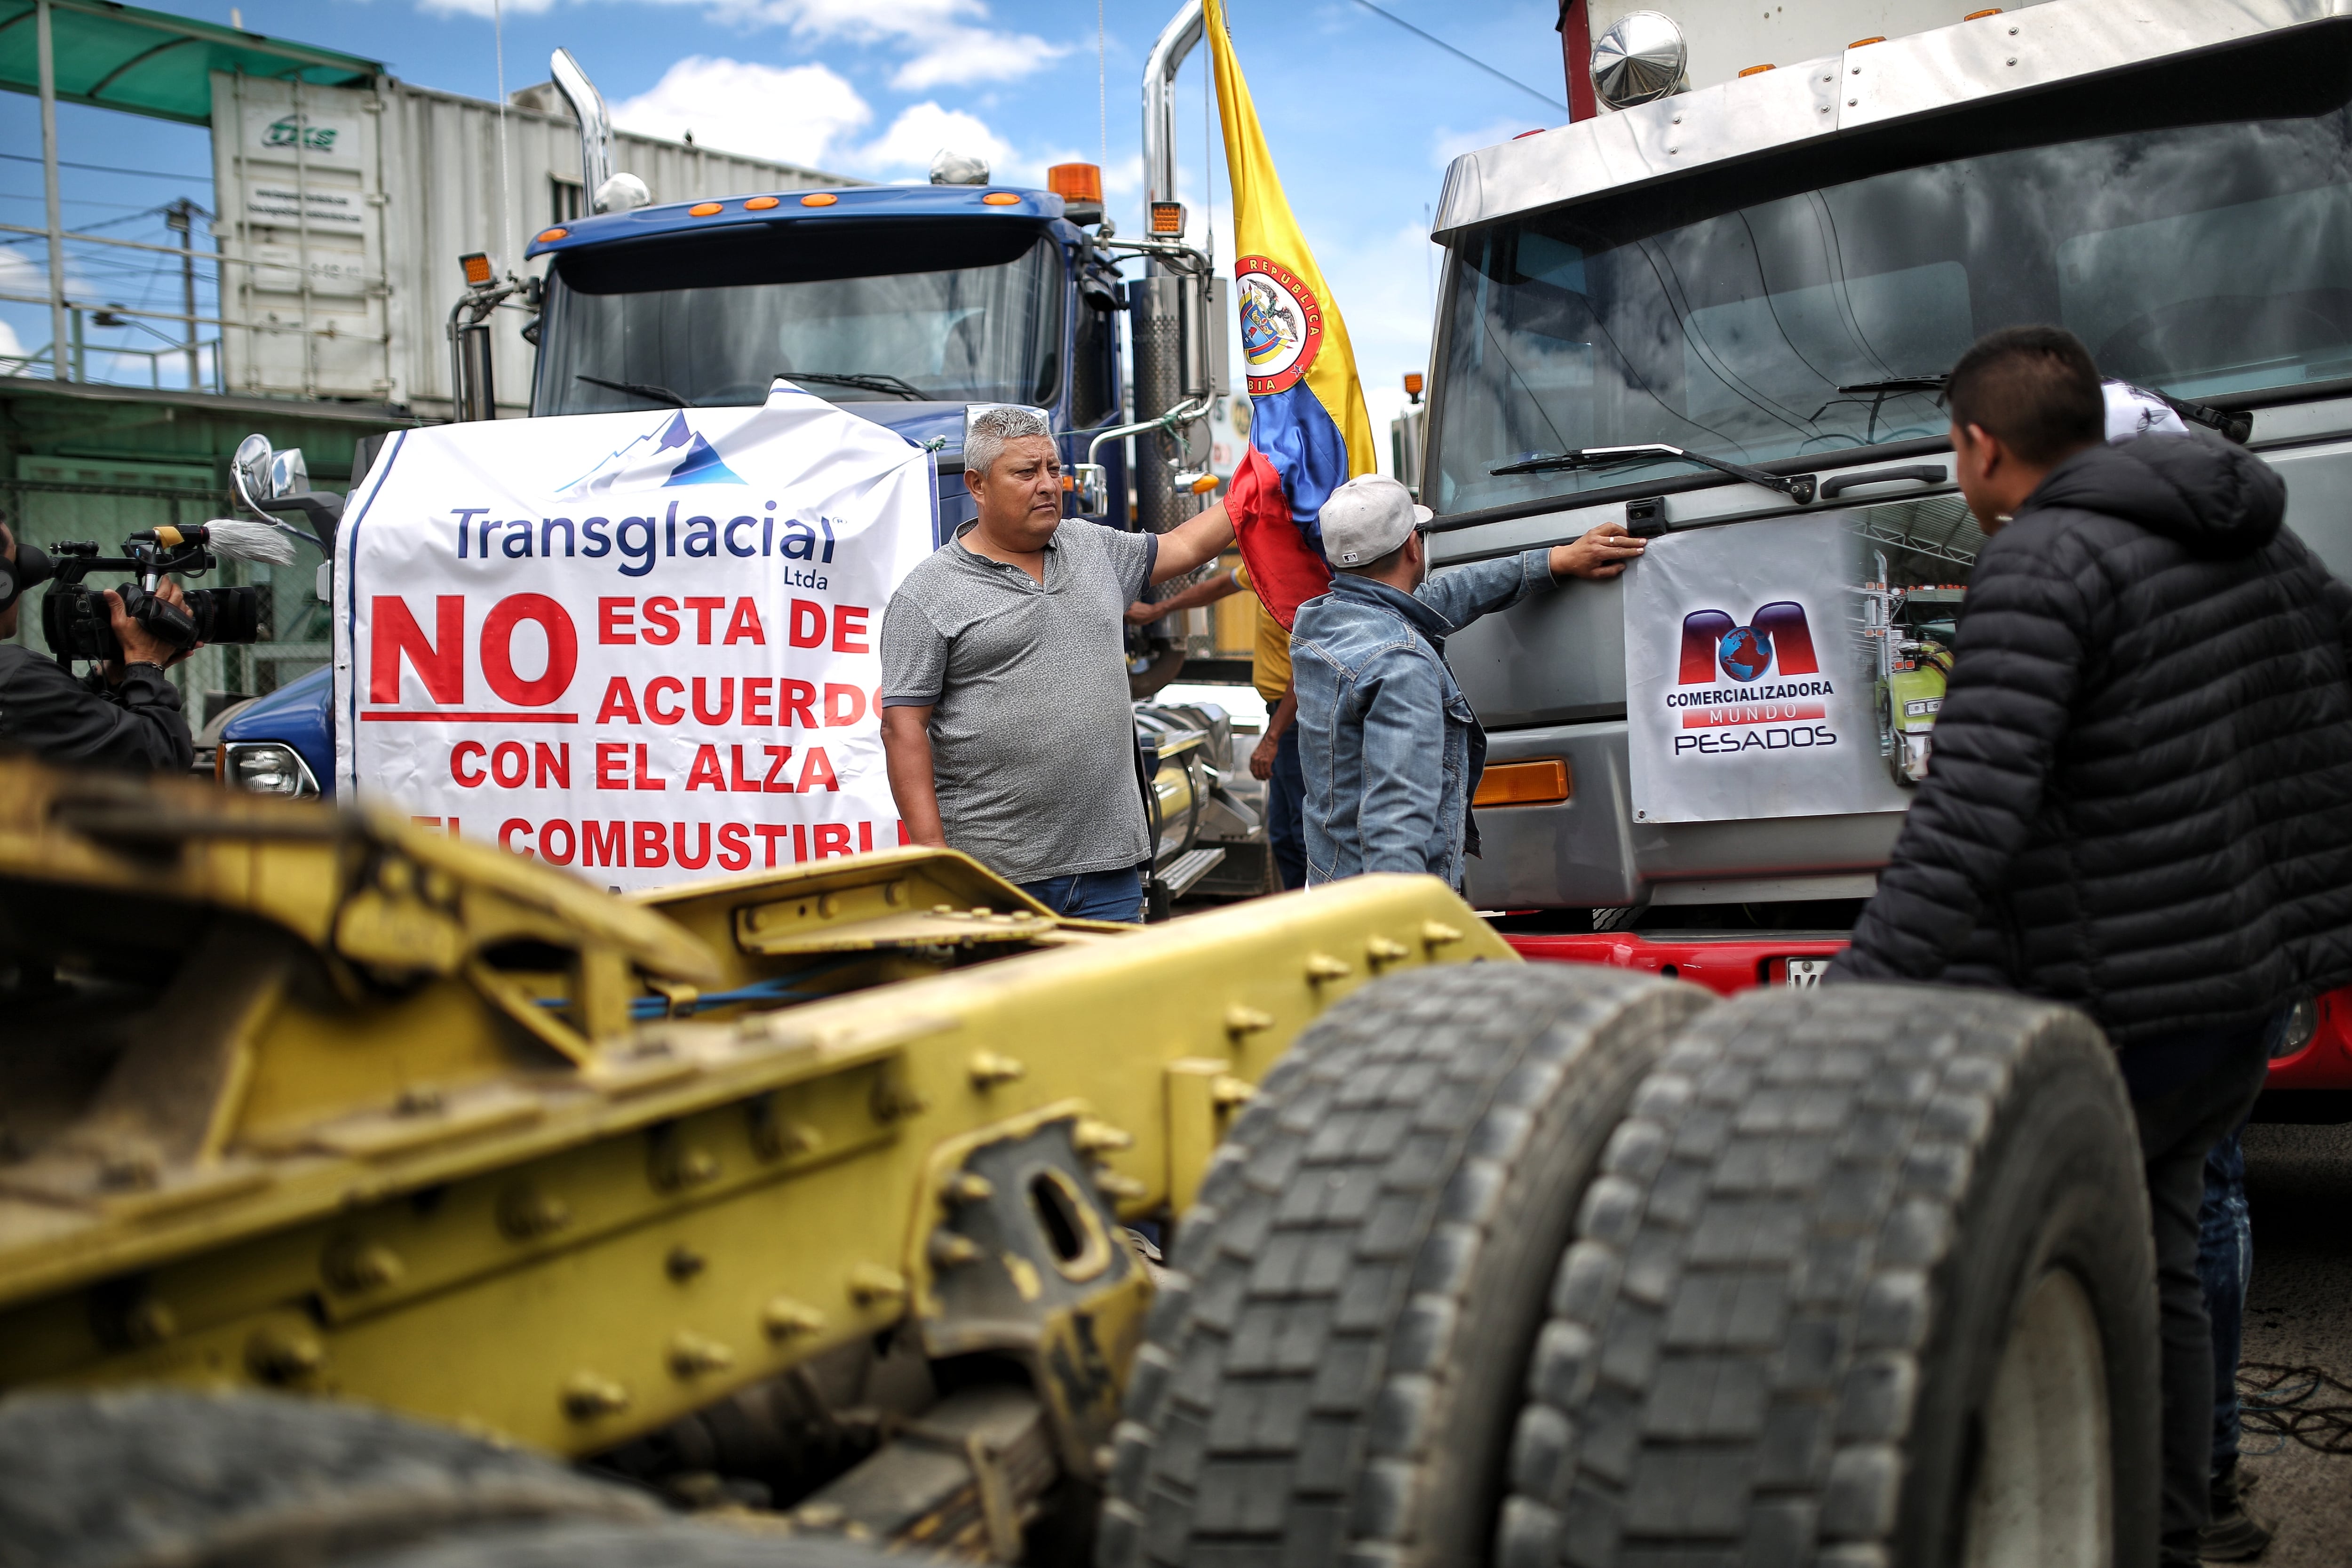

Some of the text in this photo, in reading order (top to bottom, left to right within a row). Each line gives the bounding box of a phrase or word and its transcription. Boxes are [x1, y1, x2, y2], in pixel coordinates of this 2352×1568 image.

[1249, 259, 1320, 336] REPUBLICA
[450, 500, 835, 578] Transglacial
[784, 565, 828, 590] Ltda
[167, 612, 191, 630] Panasonic
[370, 593, 869, 706] NO ESTA DE
[595, 675, 882, 728] ACUERD
[1667, 681, 1835, 708] COMERCIALIZADORA
[1709, 703, 1797, 724] MUNDO
[450, 740, 840, 793] CON EL ALZA
[1675, 725, 1837, 756] PESADOS
[498, 817, 911, 871] COMBUSTIB
